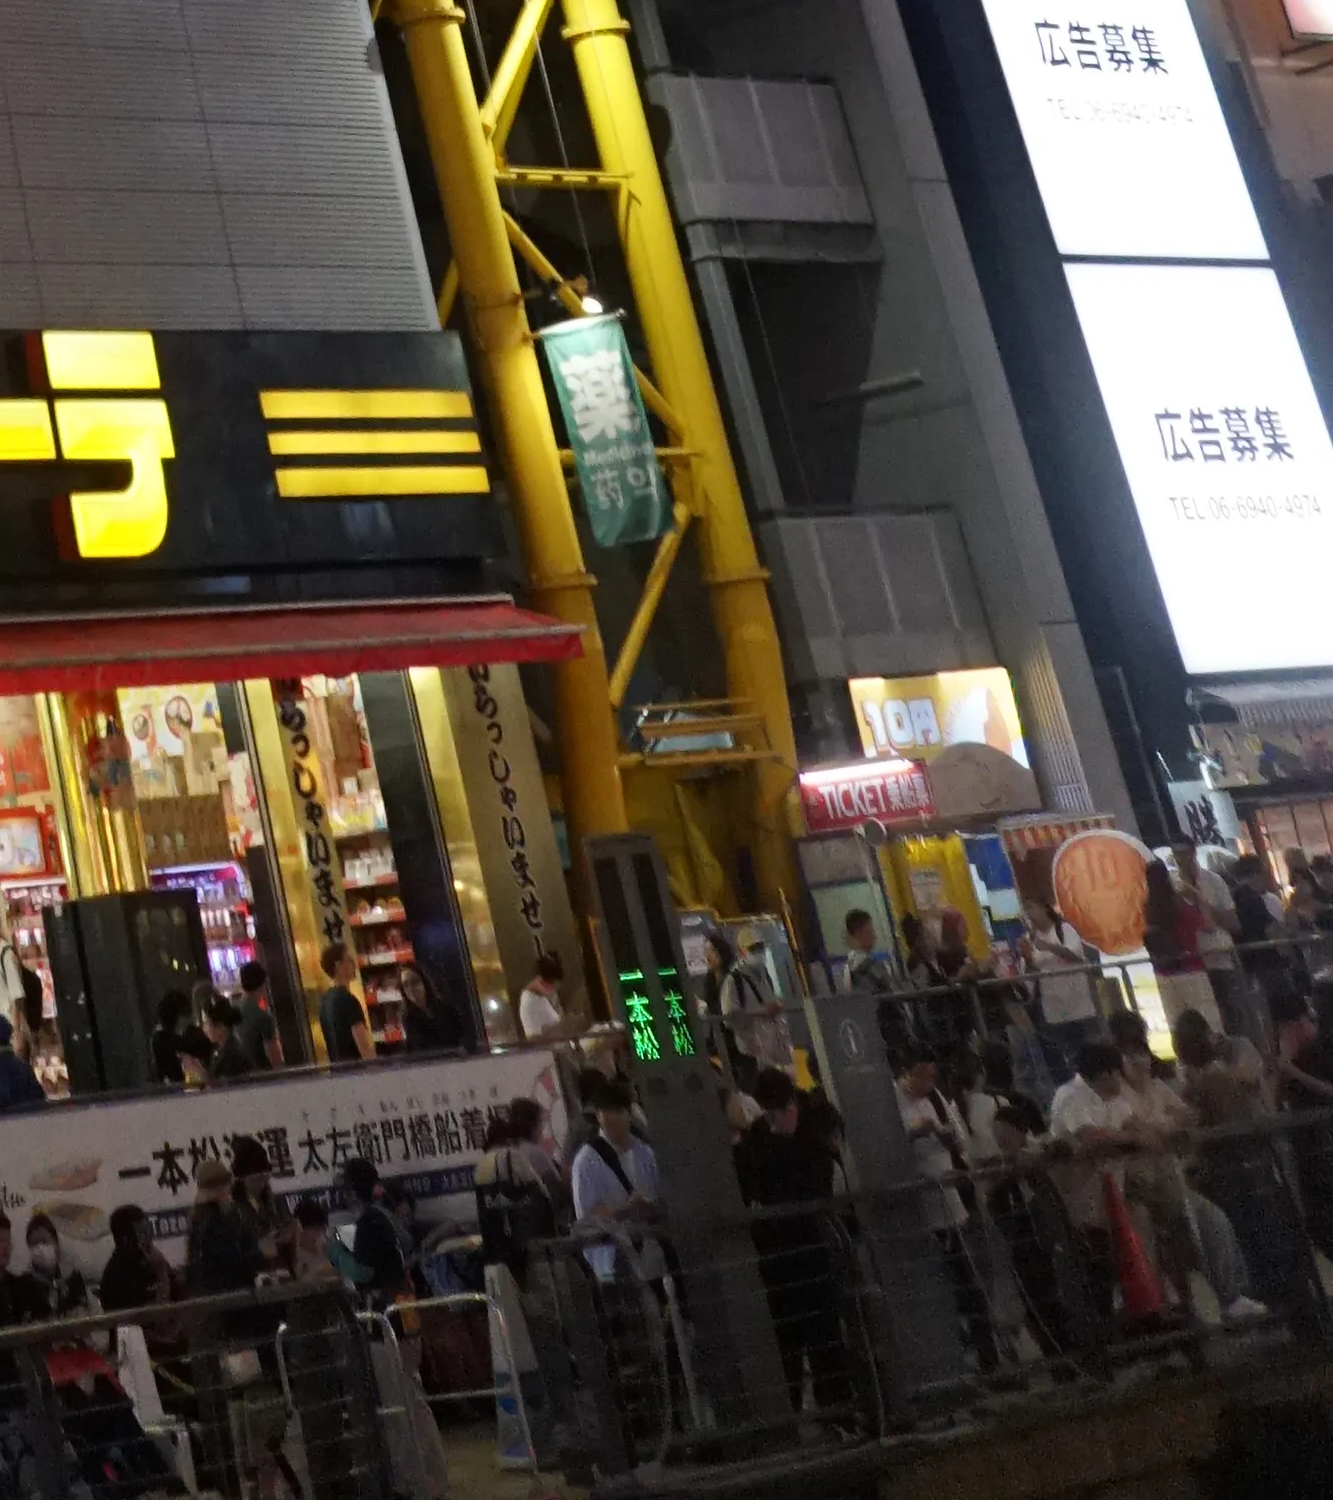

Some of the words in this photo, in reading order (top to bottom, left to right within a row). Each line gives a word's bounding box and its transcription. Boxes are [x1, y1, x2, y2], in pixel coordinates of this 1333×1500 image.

[1034, 17, 1170, 76] 広告募集
[1153, 405, 1295, 462] 広告募集
[817, 778, 887, 820] TICKET
[298, 1104, 513, 1176] 太左衛門橋船着
